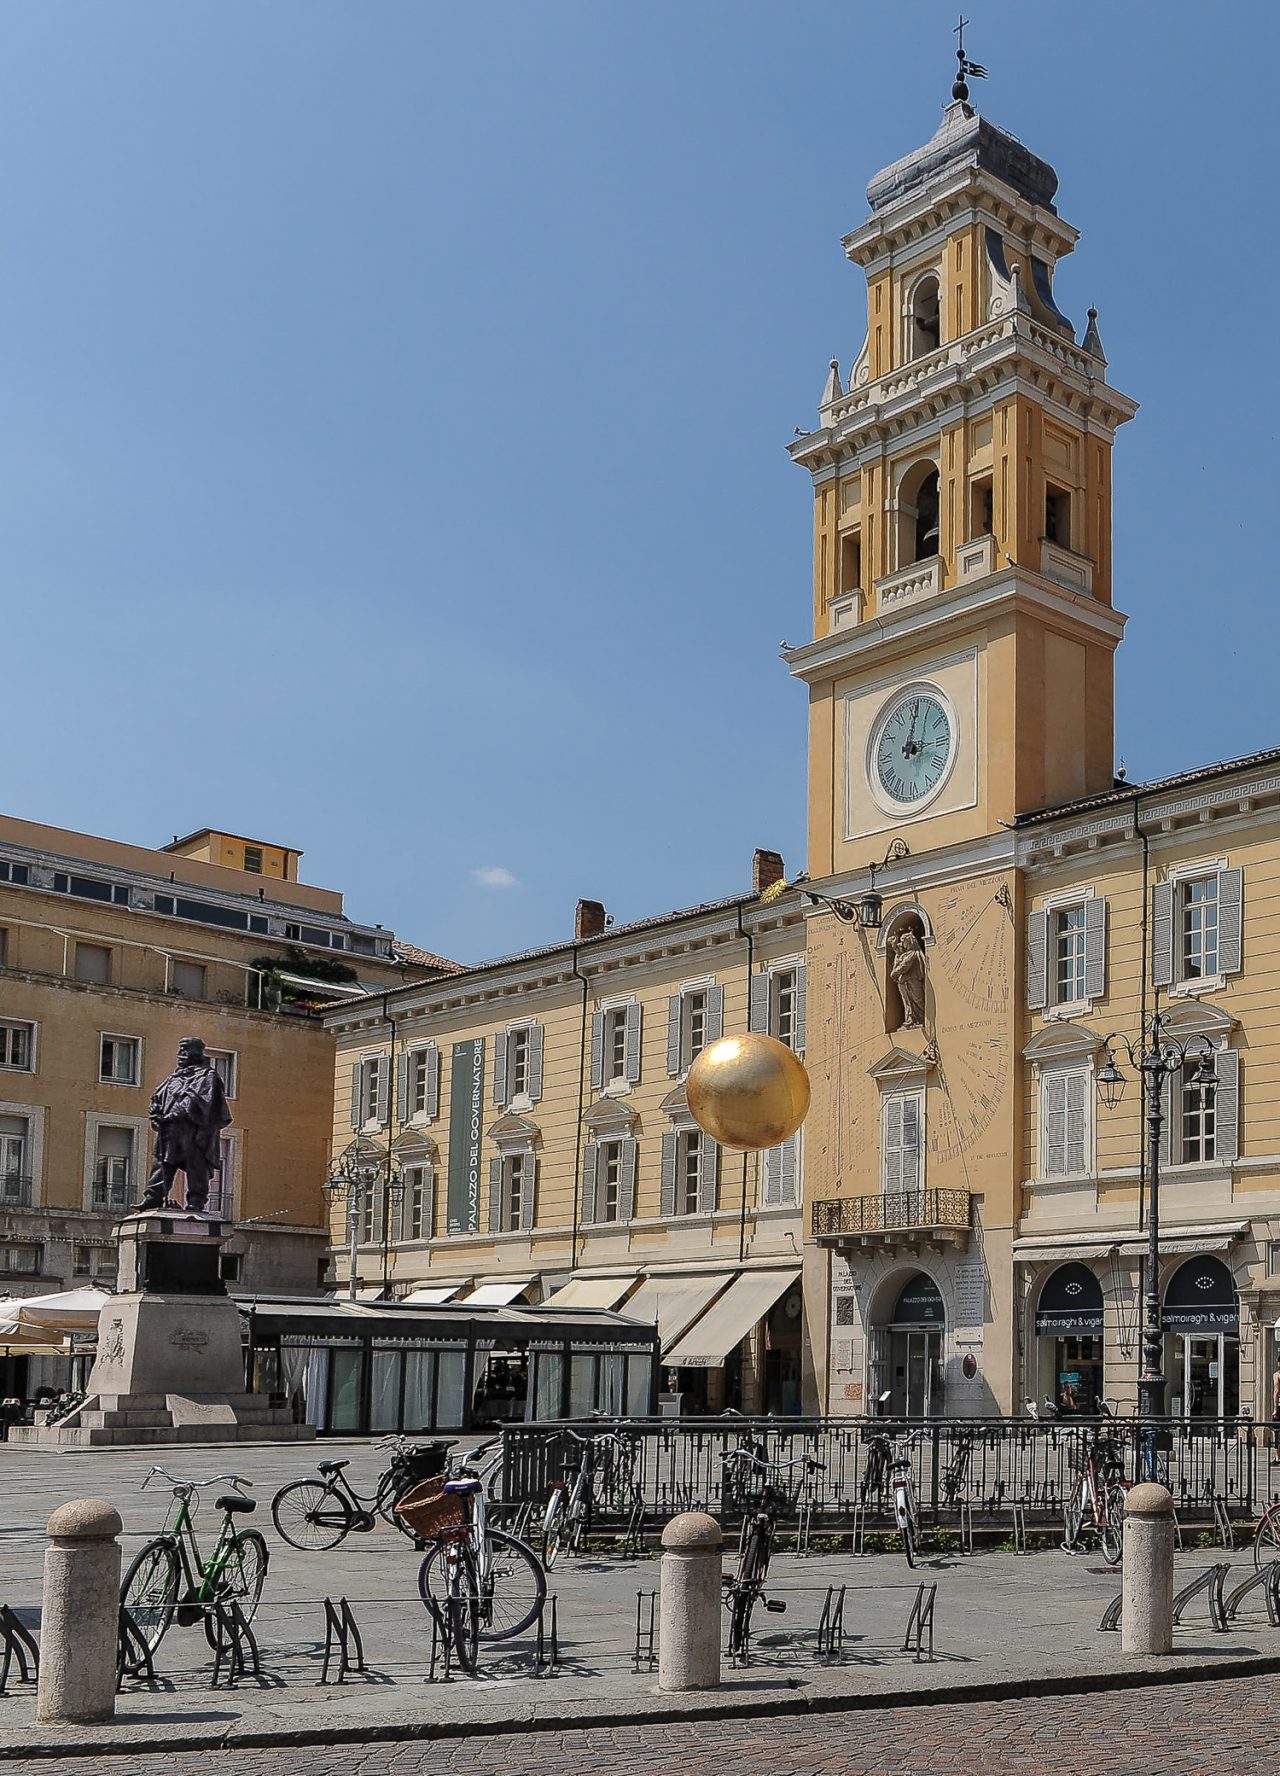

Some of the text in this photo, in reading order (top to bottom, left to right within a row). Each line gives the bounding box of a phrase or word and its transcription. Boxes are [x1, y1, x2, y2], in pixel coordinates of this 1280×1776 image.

[468, 1039, 483, 1231] PALAZZO DEL GOVERNATORE
[1036, 1316, 1077, 1329] salmoiraghi
[1162, 1312, 1208, 1326] salmoiraghi
